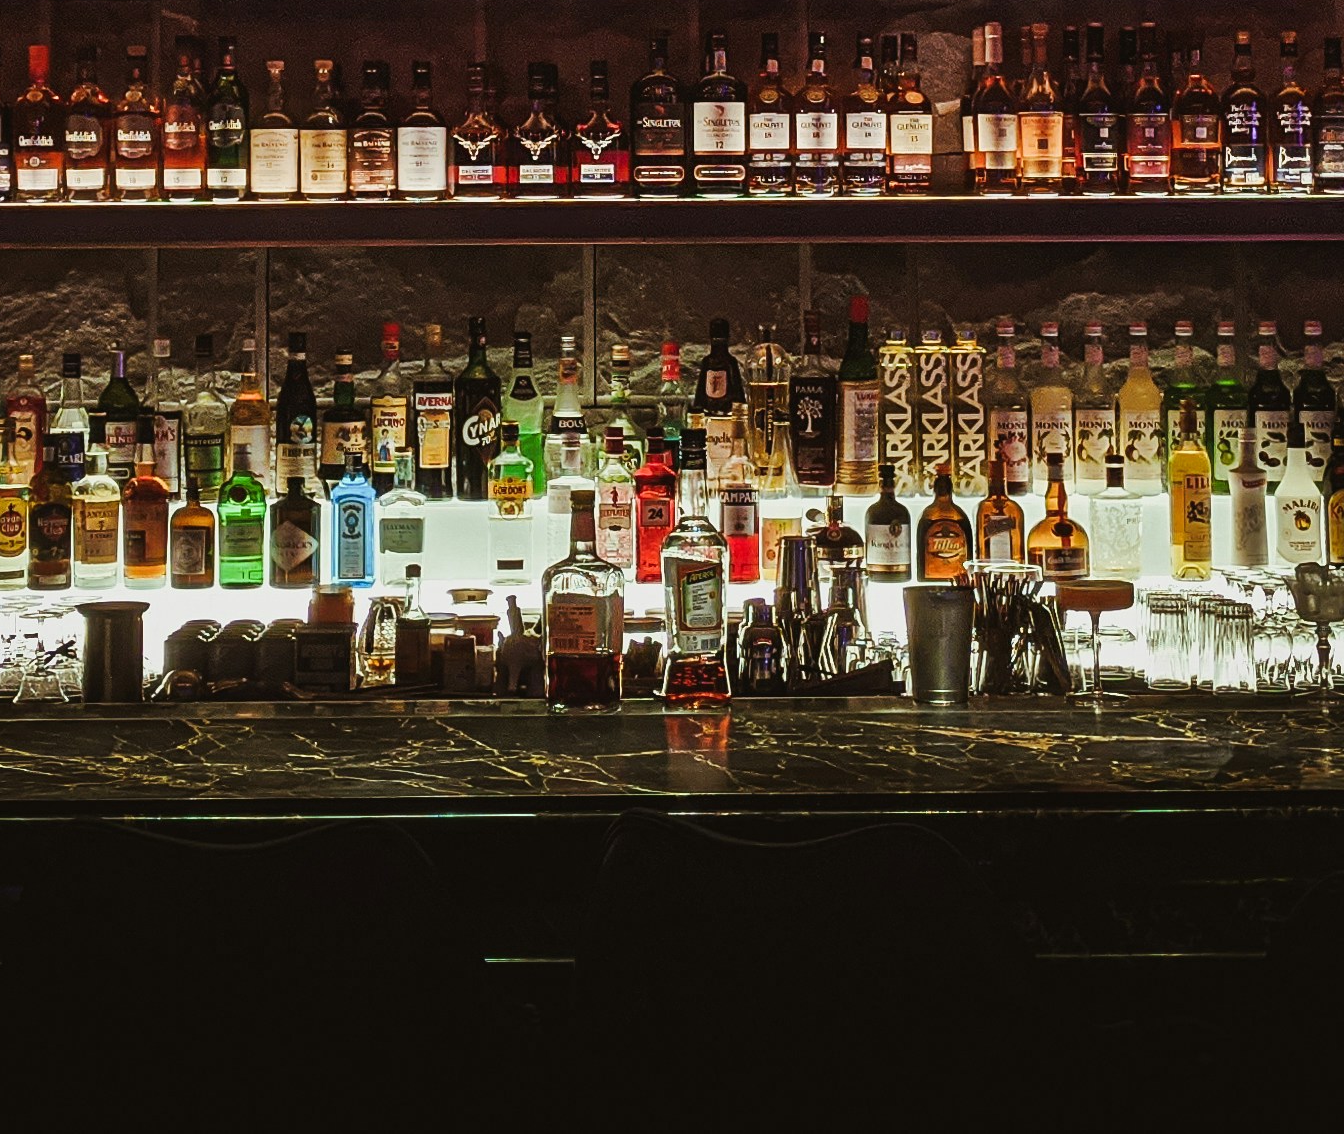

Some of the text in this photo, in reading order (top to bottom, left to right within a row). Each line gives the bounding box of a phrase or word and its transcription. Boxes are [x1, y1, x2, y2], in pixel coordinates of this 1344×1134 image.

[796, 385, 823, 393] PAMA
[559, 418, 584, 428] BOLS
[1035, 422, 1069, 430] MONIN
[1079, 421, 1112, 429] MONIN
[720, 491, 759, 503] CAMPARI
[648, 508, 663, 519] 24
[1, 524, 19, 533] Club
